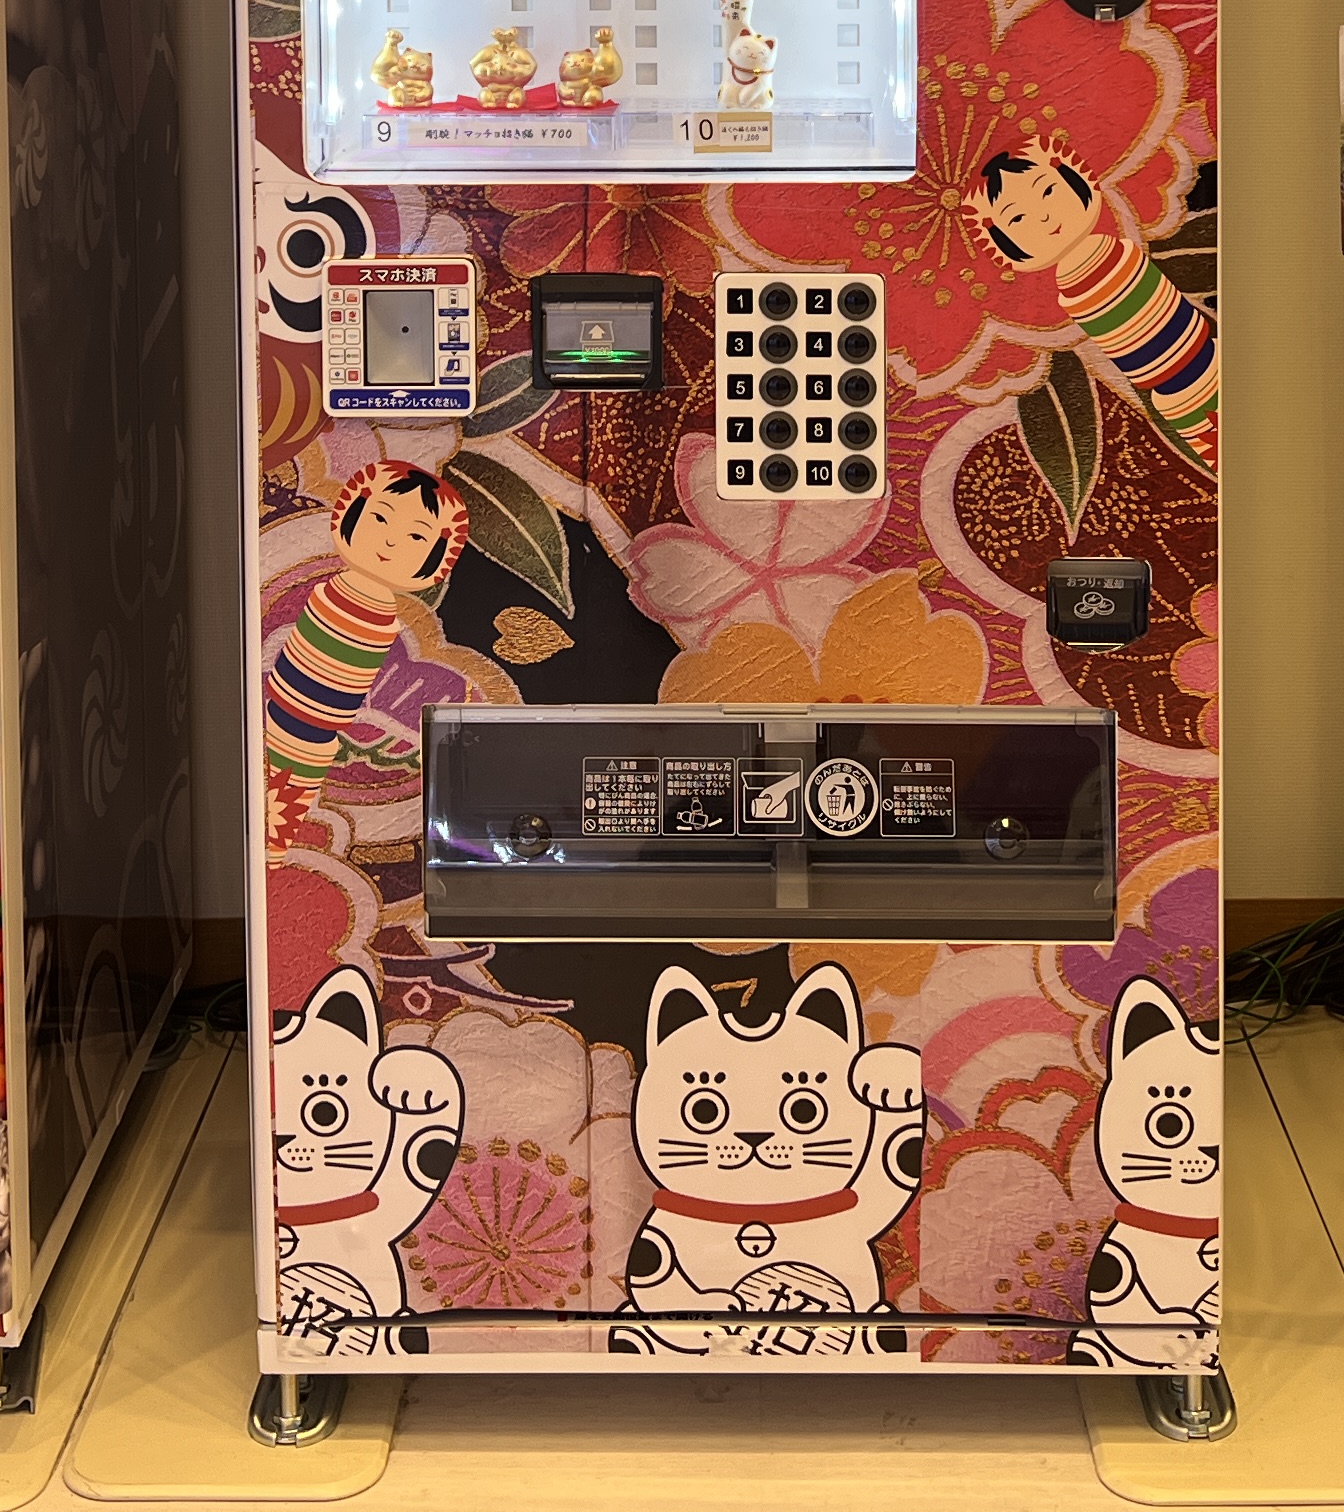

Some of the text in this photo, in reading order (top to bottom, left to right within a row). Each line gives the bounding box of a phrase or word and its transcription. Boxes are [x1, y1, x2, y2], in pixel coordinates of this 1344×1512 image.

[377, 121, 392, 142] 9
[541, 129, 572, 138] ¥700
[680, 119, 714, 141] 10
[358, 268, 438, 284] スマホ決済
[736, 294, 744, 308] 1
[814, 294, 824, 308] 2
[734, 338, 744, 352] 3
[812, 338, 824, 352] 4
[735, 381, 746, 395] 5
[813, 381, 824, 395] 6
[337, 396, 463, 410] QRコードをスキャンしてください。
[734, 423, 744, 437] 7
[813, 423, 824, 438] 8
[735, 466, 745, 480] 9
[810, 466, 830, 480] 10
[814, 763, 869, 787] のんだあとは
[818, 812, 866, 831] リサイクル
